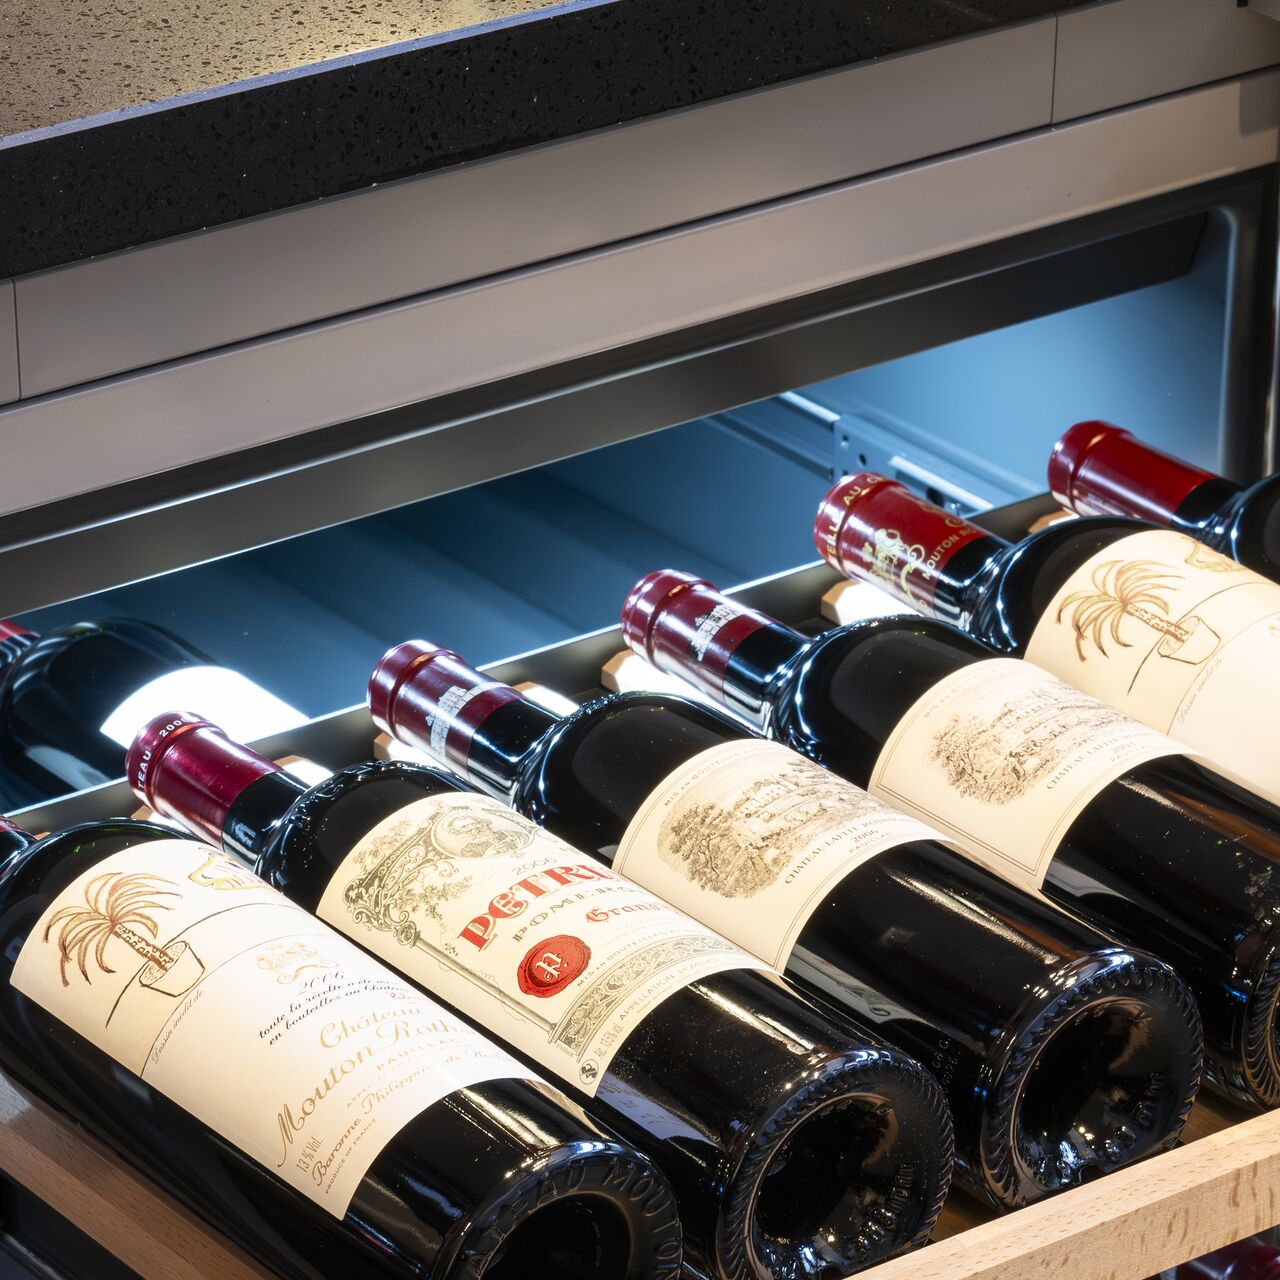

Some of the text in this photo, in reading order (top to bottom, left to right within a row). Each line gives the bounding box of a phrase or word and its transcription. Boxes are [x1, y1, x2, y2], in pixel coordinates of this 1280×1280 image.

[922, 535, 960, 580] MOUTON
[137, 751, 151, 789] TEAU
[784, 846, 826, 884] CHATEAU
[297, 971, 344, 995] 2006
[619, 974, 675, 1021] APPELLATION
[259, 1014, 286, 1039] toute
[290, 1003, 301, 1013] la
[269, 1032, 282, 1046] en
[285, 994, 341, 1030] bouteilles
[320, 1008, 421, 1048] Château
[277, 1019, 460, 1168] Mouton Roth
[296, 1156, 310, 1174] 13
[312, 1117, 362, 1187] Baronne
[325, 1157, 346, 1194] PRODUCE
